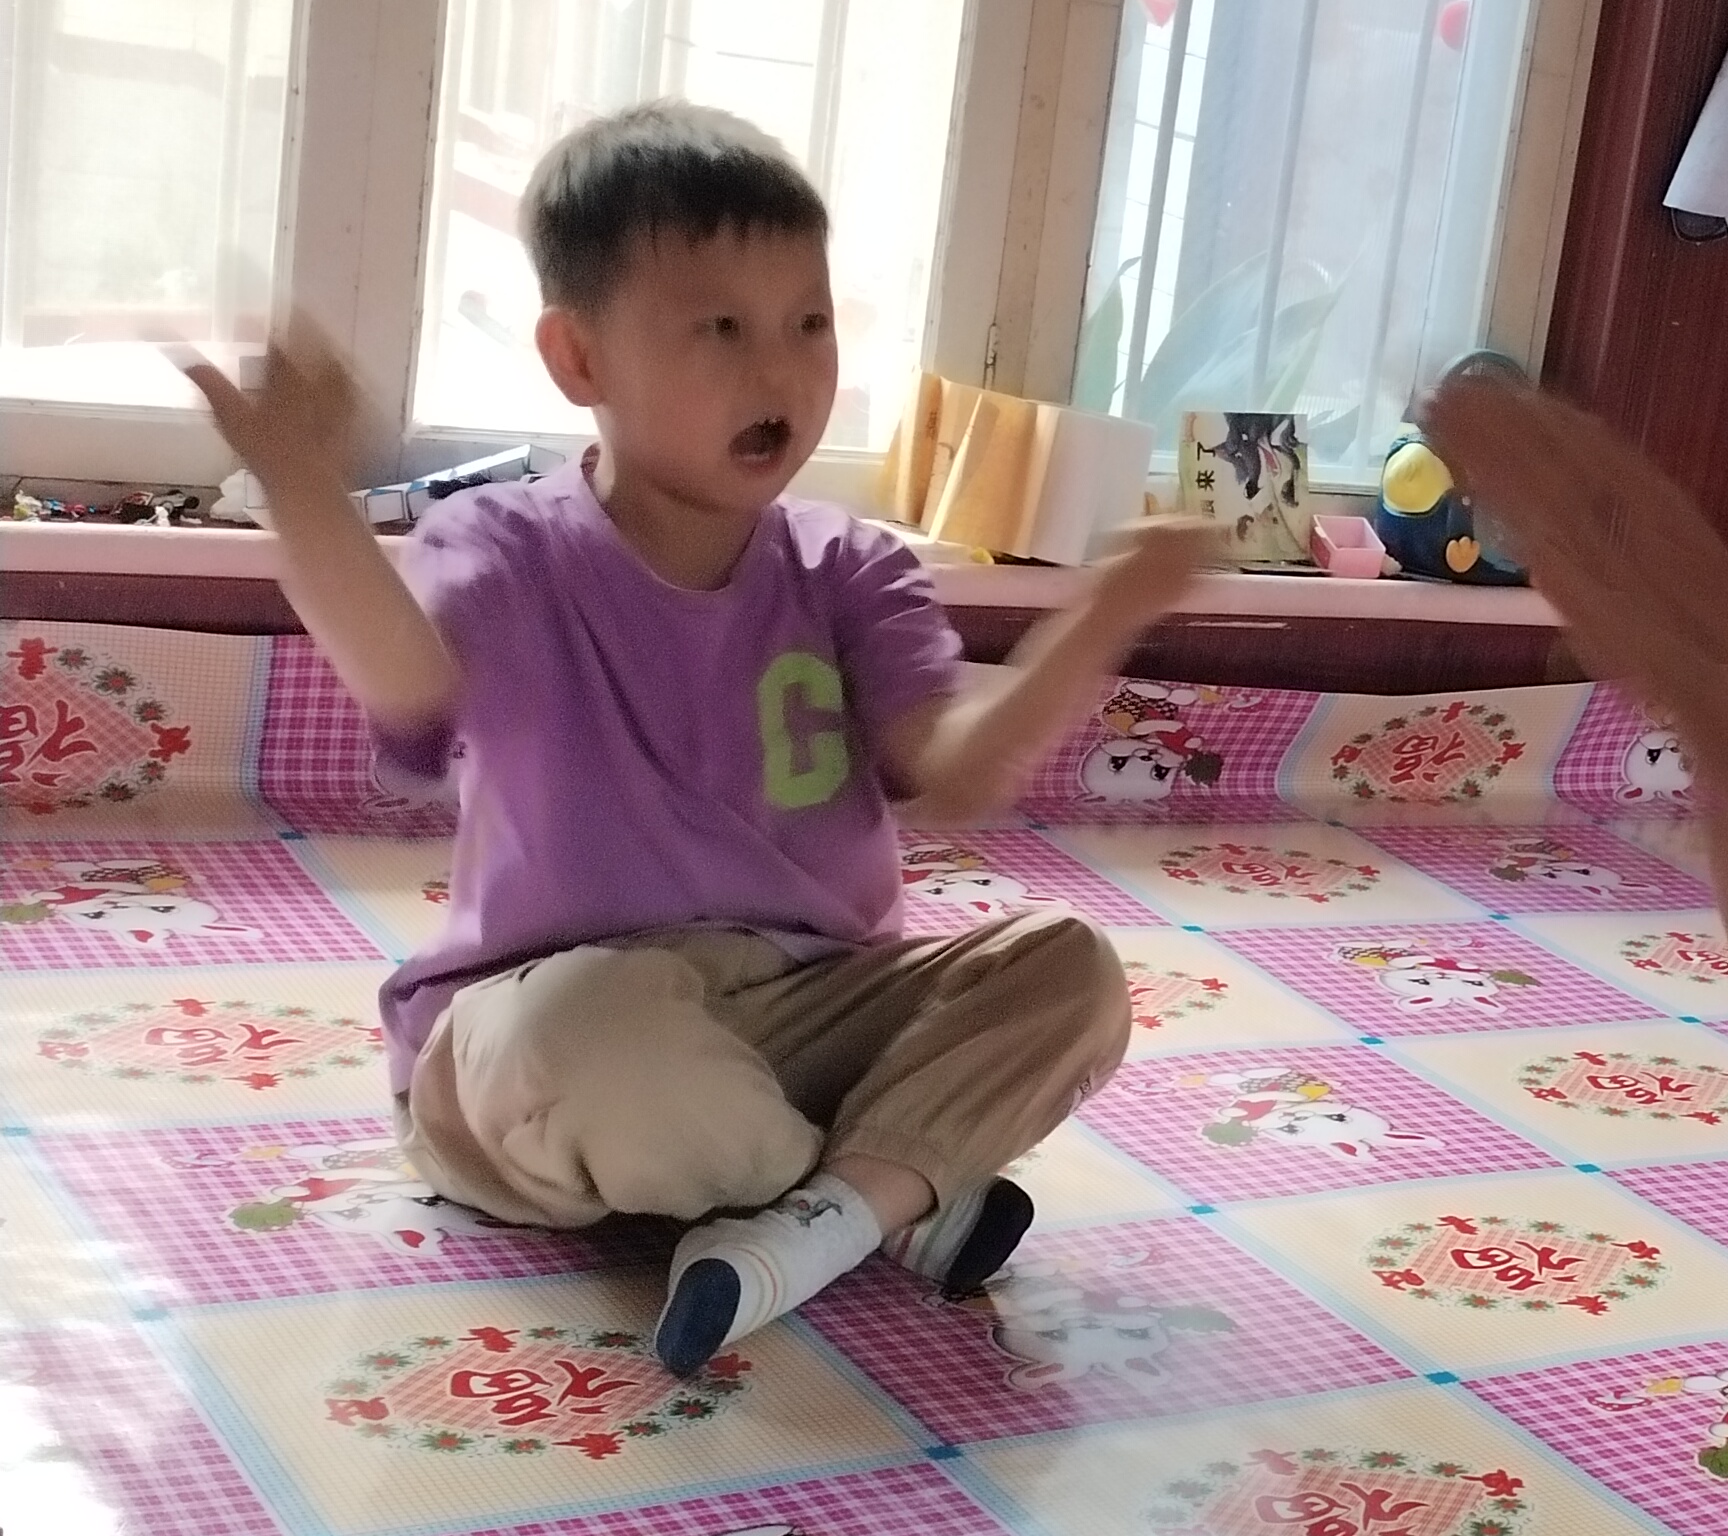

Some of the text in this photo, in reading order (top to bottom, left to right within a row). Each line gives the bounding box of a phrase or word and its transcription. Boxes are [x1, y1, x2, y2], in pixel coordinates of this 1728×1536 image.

[0, 699, 98, 787] 福
[757, 650, 851, 808] C
[1389, 731, 1466, 784] 福
[1221, 860, 1319, 887] 福
[142, 1022, 306, 1066] 福
[1586, 1070, 1700, 1105] 福
[1450, 1239, 1588, 1291] 福
[449, 1359, 640, 1426] 福
